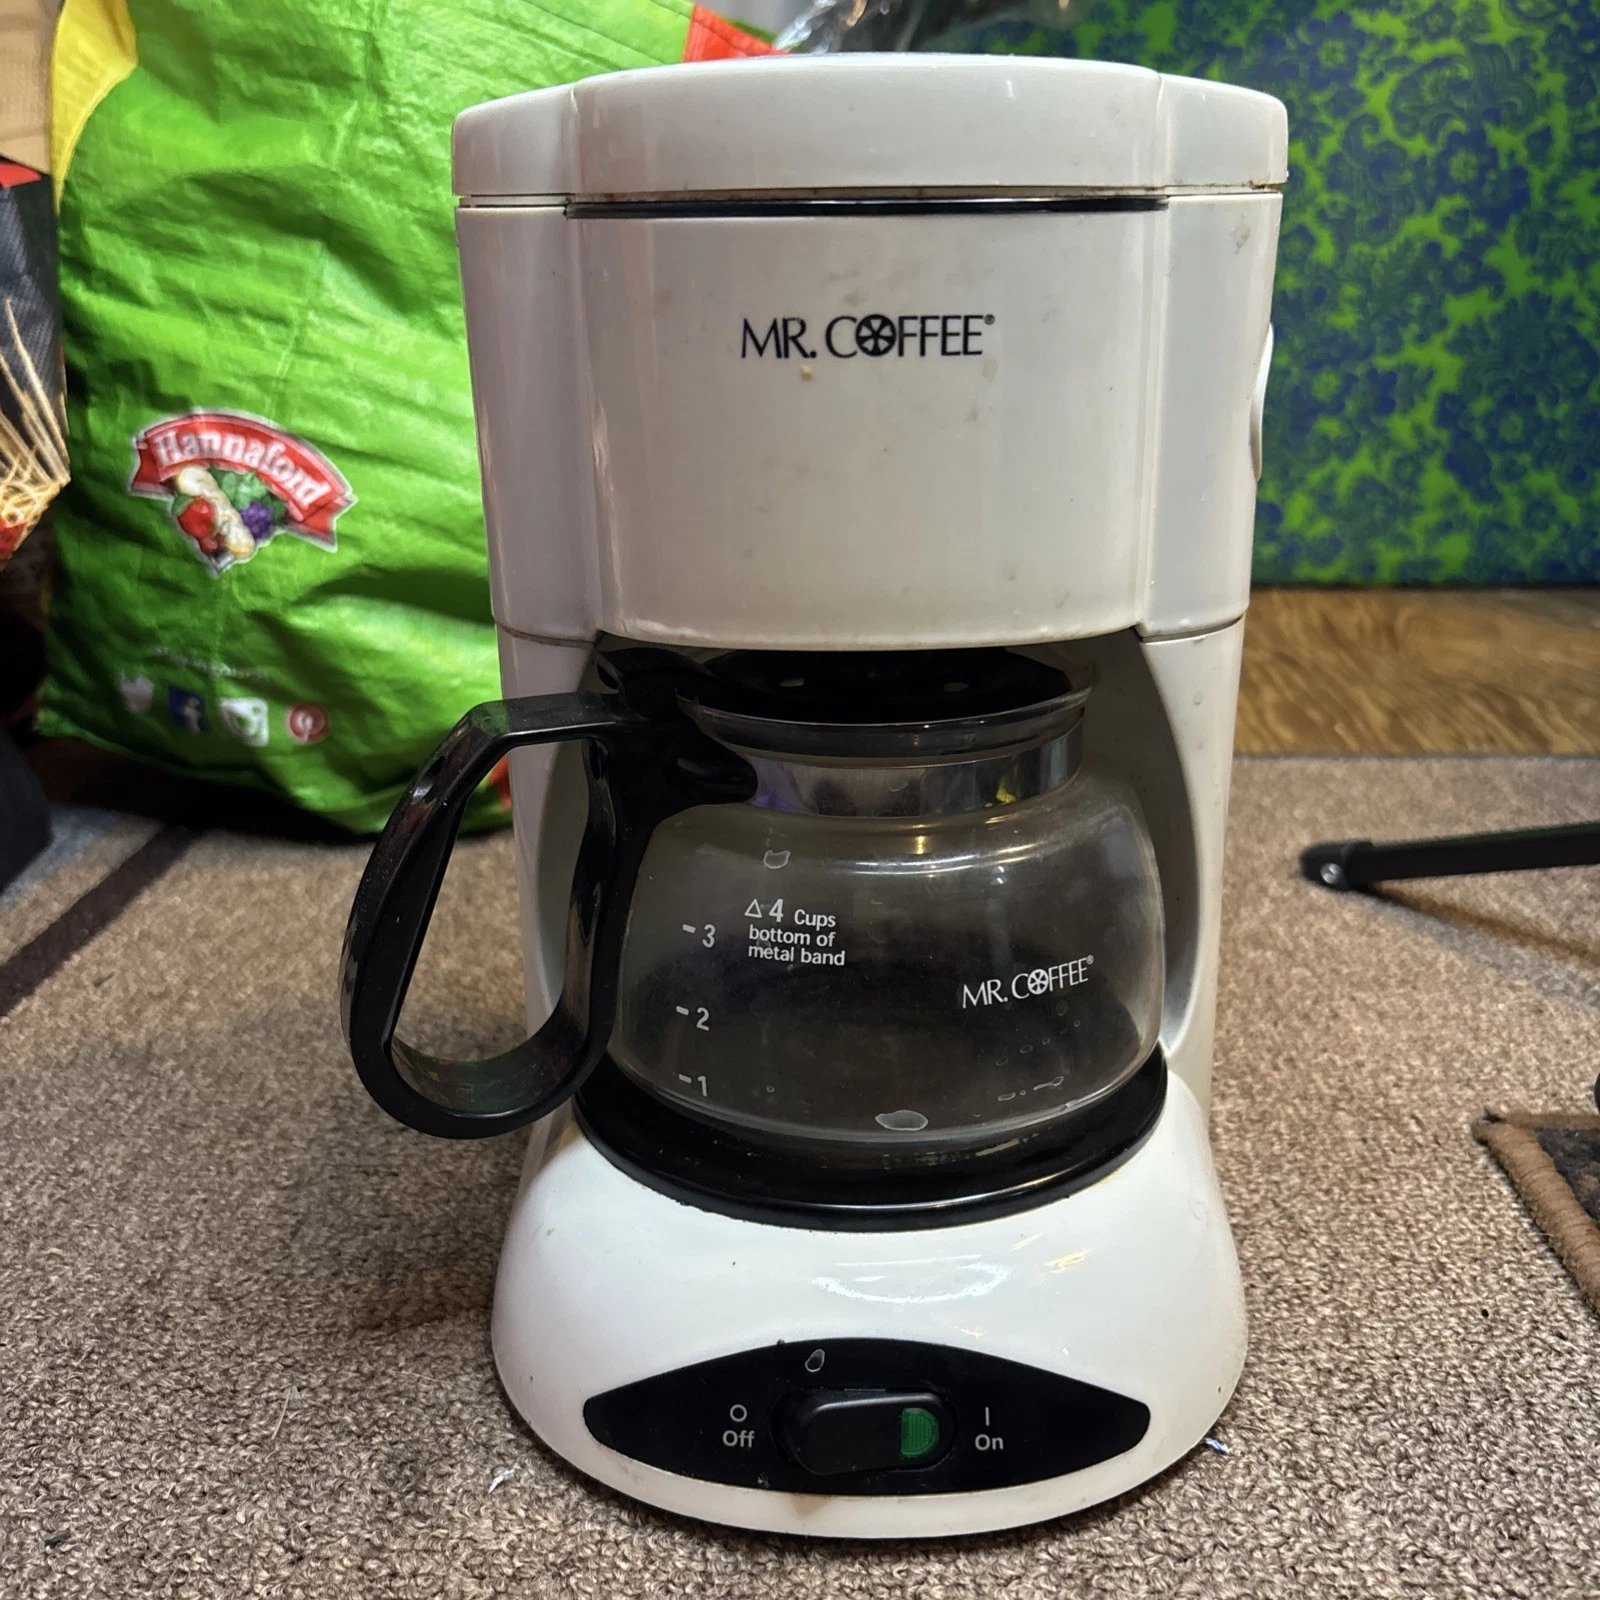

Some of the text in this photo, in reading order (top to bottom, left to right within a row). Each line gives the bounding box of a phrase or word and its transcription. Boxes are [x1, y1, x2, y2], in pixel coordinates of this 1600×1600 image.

[741, 317, 817, 359] MR.
[154, 428, 330, 507] Hannaford
[769, 898, 837, 931] 4 Cups
[702, 924, 716, 948] 3
[749, 924, 837, 947] bottom of
[748, 945, 846, 966] metal band
[962, 979, 1009, 1009] MR.
[696, 1007, 710, 1031] 2
[697, 1075, 708, 1097] 1
[722, 1430, 755, 1448] Off
[974, 1434, 1004, 1450] On
